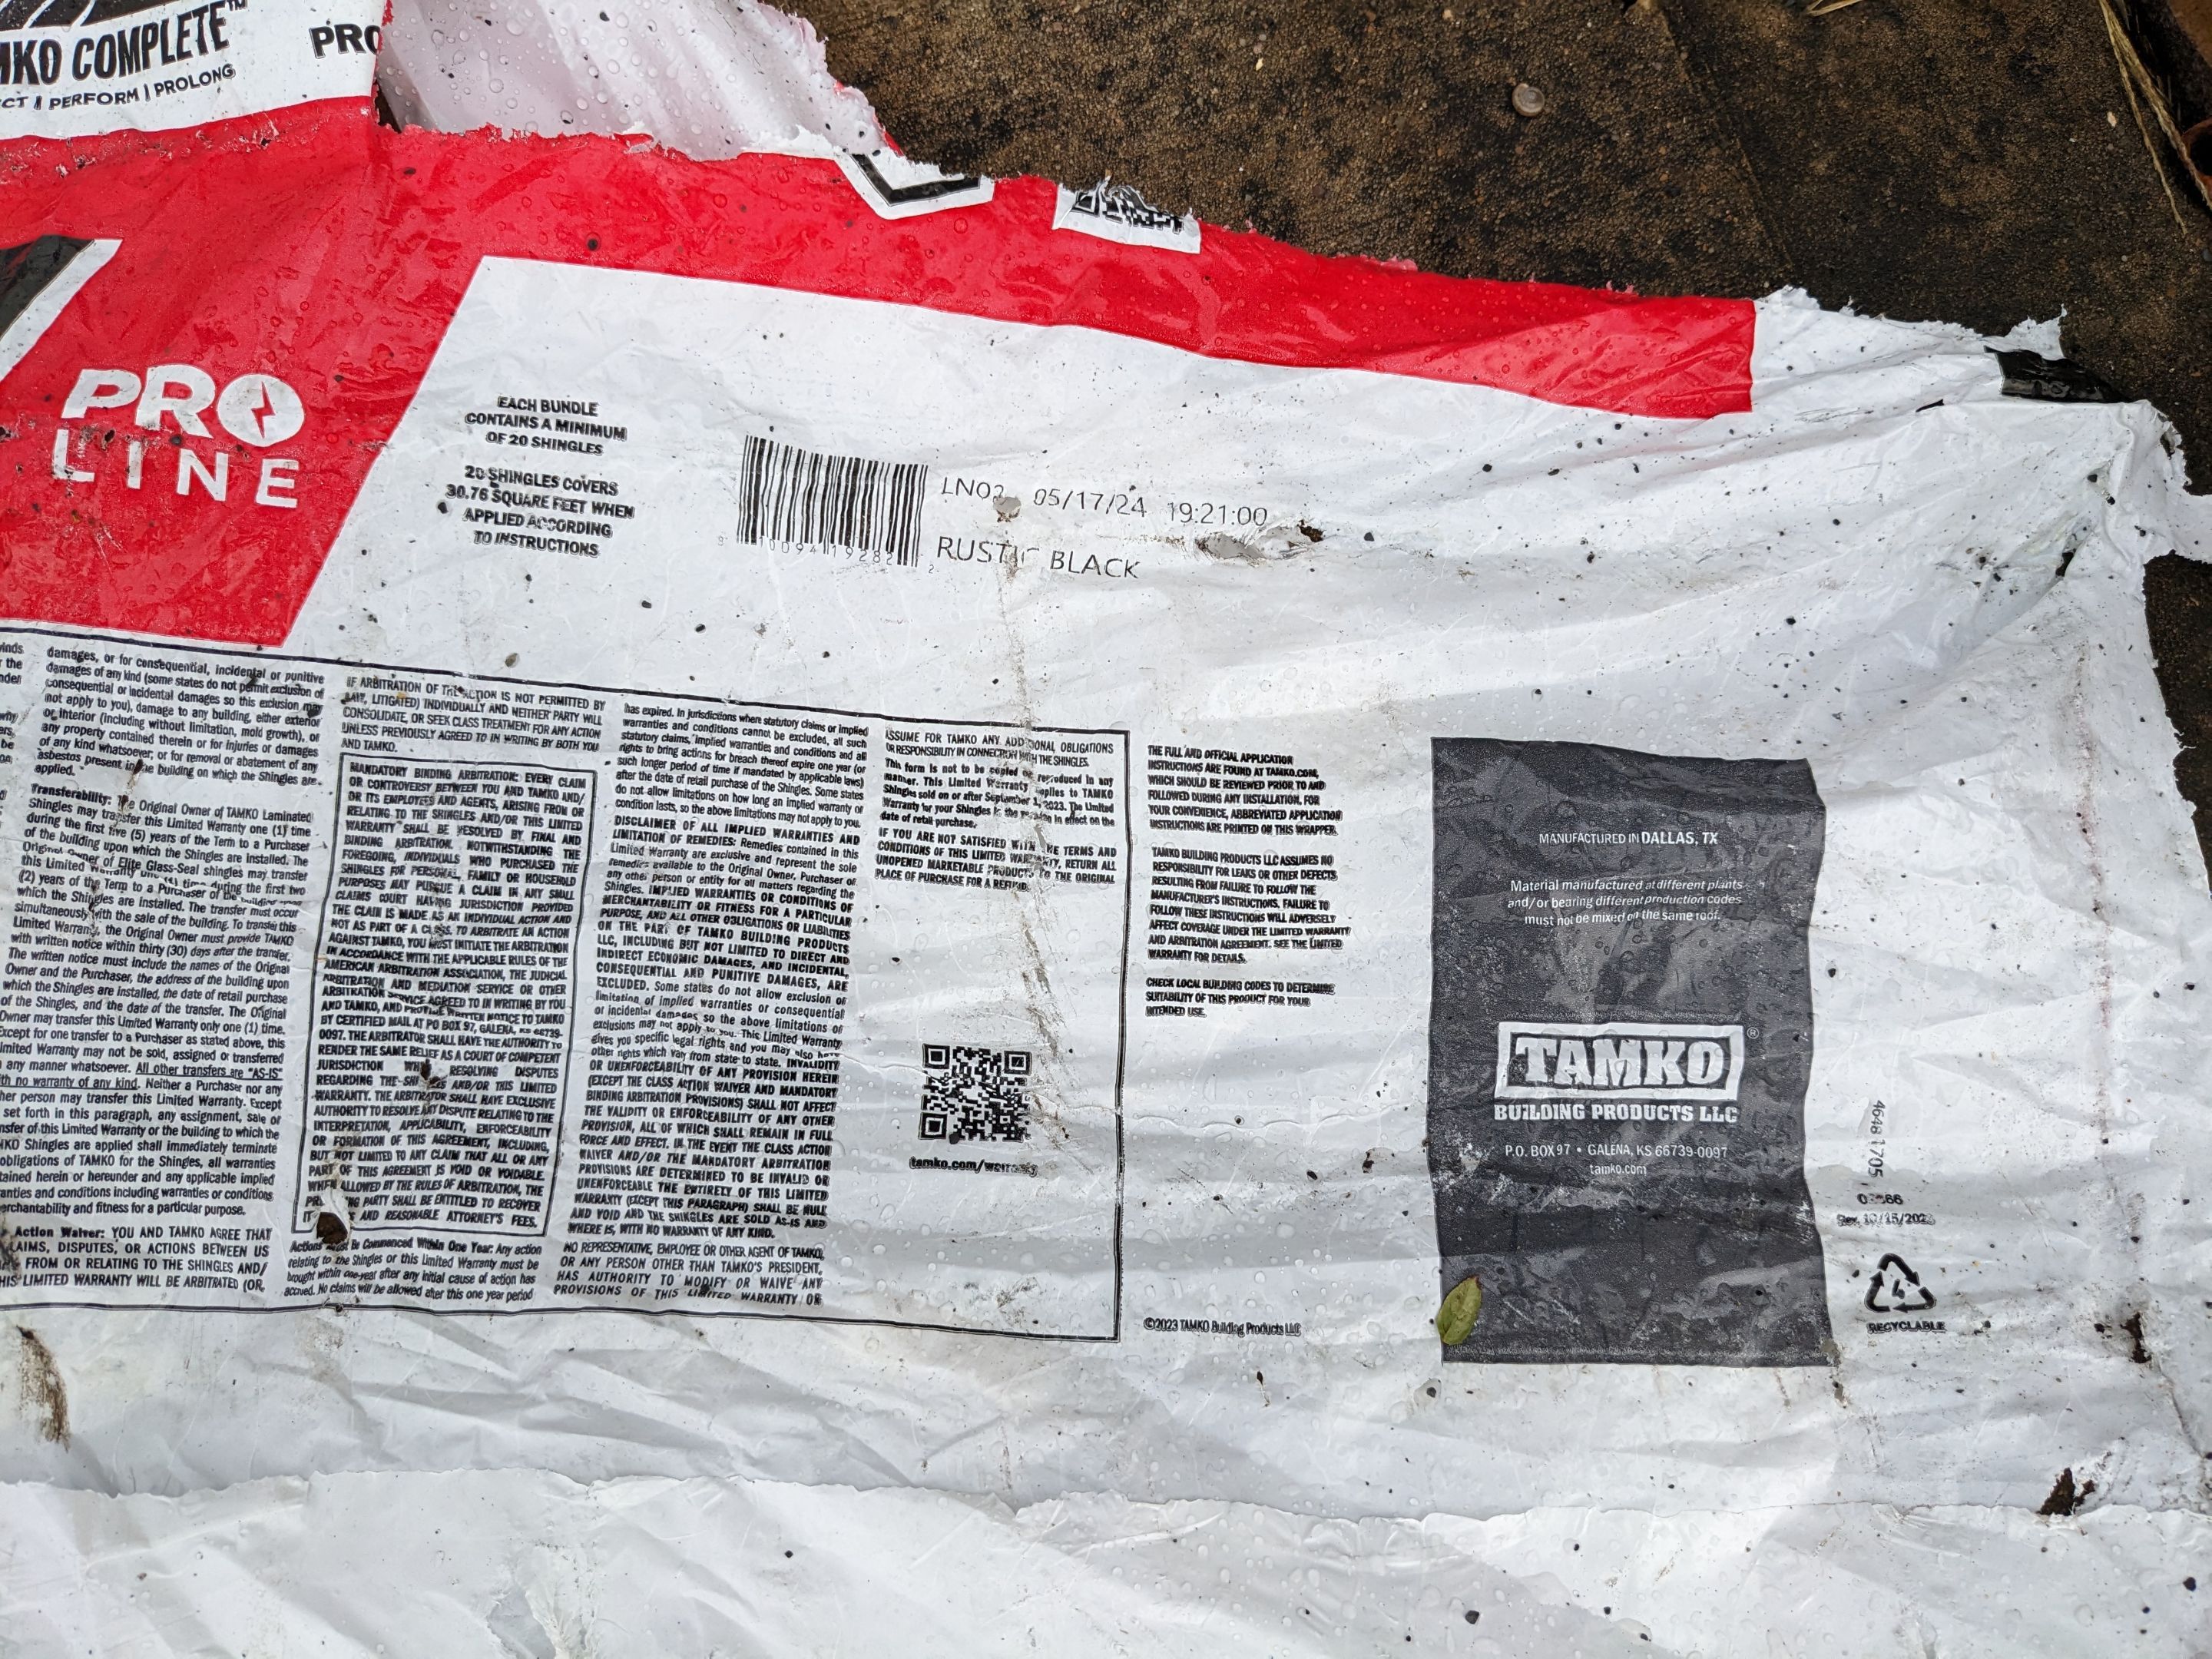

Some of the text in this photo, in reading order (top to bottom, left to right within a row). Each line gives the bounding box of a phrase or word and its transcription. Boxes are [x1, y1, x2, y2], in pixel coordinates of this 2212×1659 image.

[72, 0, 230, 81] COMPLETE
[0, 63, 236, 110] CT PERFORM PROLONG
[61, 364, 305, 447] PRO
[498, 396, 599, 417] EACH BUNDLE
[465, 412, 628, 441] CONTAINS A MINIMUM
[485, 432, 604, 455] OF 20 SHINGLES
[52, 429, 300, 508] LINE
[464, 465, 618, 496] 20 SHINGLES COVERS
[445, 484, 634, 519] 30.76 SQUARE FEET WHEN
[1033, 488, 1147, 518] 05/17/24
[1167, 501, 1268, 526] 19:21:00
[462, 508, 613, 538] APPLIED ACCORDING
[474, 530, 599, 558] TO INSTRUCTIONS
[1051, 550, 1140, 578] BLACK
[47, 647, 99, 664] damages,
[104, 654, 116, 664] or
[119, 654, 133, 665] for
[136, 657, 210, 676] consequential,
[270, 671, 281, 680] or
[285, 671, 324, 685] punitive
[1148, 746, 1293, 765] THE FULL AND OFFICIAL APPLICATION
[349, 762, 408, 777] MANDATORY
[414, 768, 452, 780] BINDING
[525, 773, 553, 785] EVERY
[558, 777, 587, 789] CLAIM
[1148, 760, 1203, 772] INSTRUCTIONS
[1205, 763, 1221, 773] ARE
[1224, 764, 1251, 776] FOUND
[1254, 767, 1263, 777] AT
[1147, 775, 1326, 790] WHICH SHOULD BE REVIEWED PRIOR TO AND
[1148, 790, 1190, 801] FOLLOWED
[1191, 792, 1221, 803] DURING
[1224, 794, 1240, 803] ANY
[1304, 796, 1320, 805] FOR
[1148, 805, 1171, 816] YOUR
[1230, 810, 1286, 820] ABBREVIATED
[1289, 810, 1343, 820] APPLICATION
[614, 815, 860, 845] DISCLAIMER OF ALL IMPLIED WARRANTIES AND
[1150, 820, 1205, 832] INSTRUCTIONS
[1207, 822, 1221, 833] ARE
[1224, 823, 1259, 834] PRINTED
[1261, 825, 1272, 834] ON
[1275, 825, 1293, 834] THIS
[879, 827, 889, 837] IF
[892, 829, 912, 839] YOU
[916, 830, 935, 843] ARE
[938, 833, 955, 845] NOT
[960, 836, 1006, 849] SATISFIED
[1063, 846, 1094, 856] TERMS
[1098, 846, 1117, 857] AND
[1539, 833, 1626, 845] MANUFACTURED
[1628, 833, 1639, 843] IN
[1703, 832, 1718, 844] TX
[1152, 847, 1334, 866] TAMKO BUILDING PRODUCTS LLC ASSUMES NO
[1511, 879, 1743, 892] Material manufactured at different plants
[1508, 895, 1741, 909] and/or bearing different production codes
[1525, 915, 1554, 926] must
[1557, 915, 1573, 926] not
[1576, 913, 1589, 925] be
[1592, 912, 1625, 923] mixed
[1628, 911, 1639, 920] on
[1642, 909, 1659, 920] the
[1661, 910, 1693, 922] same
[1146, 977, 1174, 988] CHECK
[1177, 979, 1200, 989] LOCAL
[1203, 979, 1242, 991] BUILDING
[1244, 981, 1271, 992] CODES
[1273, 982, 1284, 992] TO
[1196, 993, 1206, 1003] OF
[1209, 993, 1226, 1004] THIS
[1229, 994, 1267, 1005] PRODUCT
[1268, 995, 1285, 1005] FOR
[1287, 995, 1310, 1007] YOUR
[1515, 1037, 1724, 1086] TAMKO
[1494, 1104, 1737, 1123] BUILDING PRODUCTS LLC
[1505, 1144, 1727, 1159] P.O. BOX 97 GALENA, KS 66739-0097
[1590, 1163, 1647, 1176] tamko.com
[560, 1256, 575, 1267] OR
[579, 1256, 601, 1267] ANY
[606, 1257, 645, 1269] PERSON
[652, 1258, 684, 1270] OTHER
[689, 1260, 714, 1271] THAN
[721, 1260, 763, 1273] TAMKO'S
[23, 1274, 69, 1286] LIMITED
[74, 1274, 131, 1287] WARRANTY
[136, 1274, 161, 1287] WILL
[166, 1275, 180, 1288] BE
[183, 1276, 238, 1290] ARBITRATED
[1180, 1319, 1210, 1332] TAMKO
[1246, 1322, 1284, 1335] Products
[1285, 1323, 1301, 1336] LLC
[1866, 1323, 1947, 1333] RECYCLABLE
